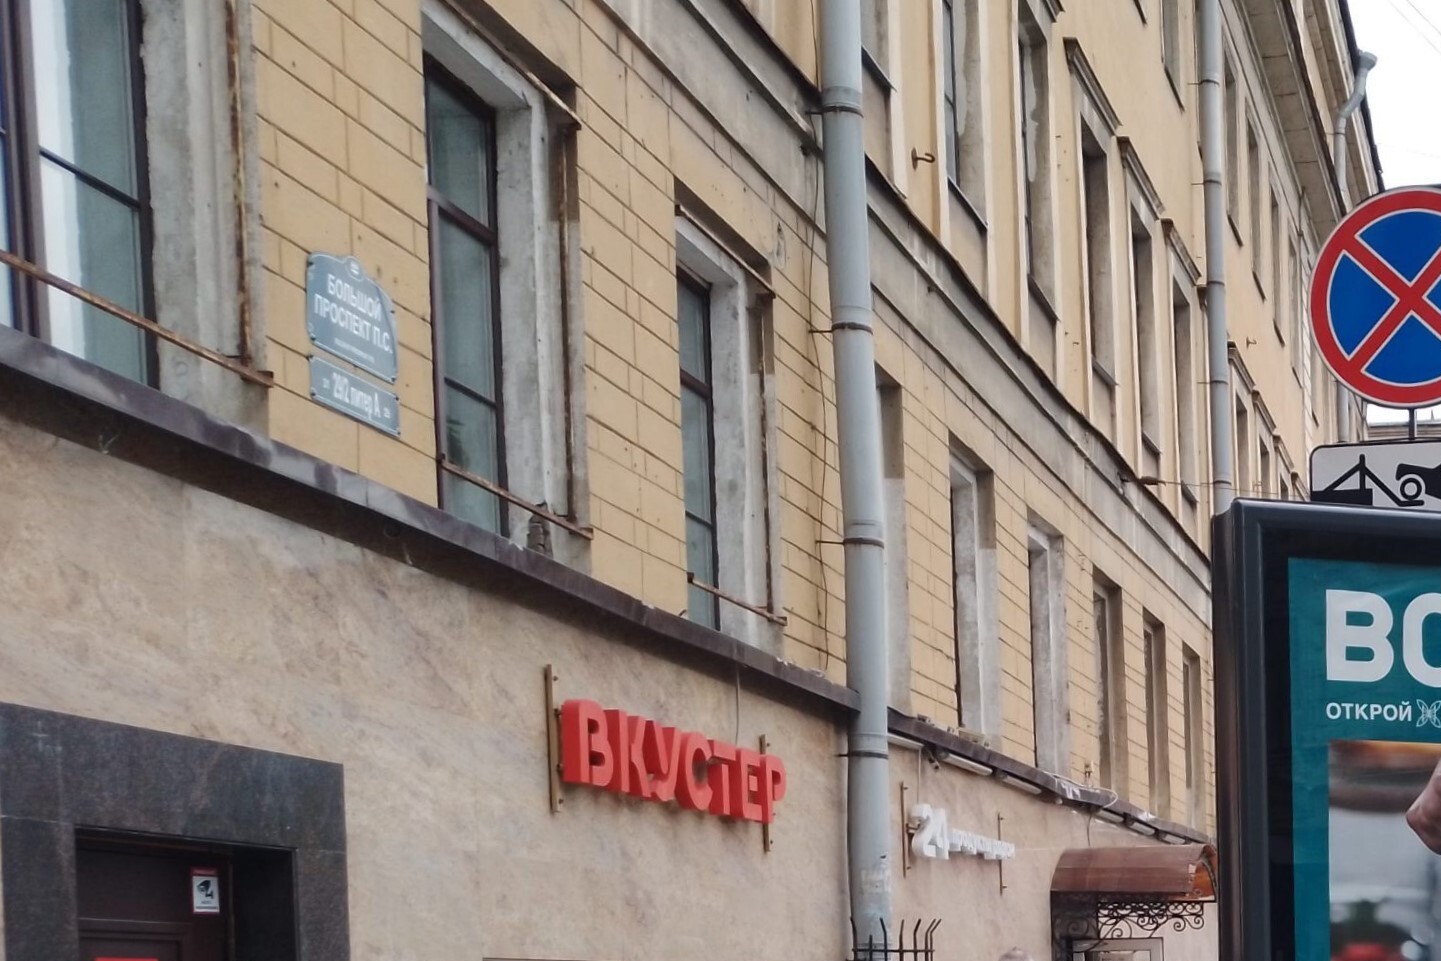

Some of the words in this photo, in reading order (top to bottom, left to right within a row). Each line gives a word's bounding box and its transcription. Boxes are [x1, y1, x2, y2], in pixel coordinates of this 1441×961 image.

[314, 293, 371, 341] ПРОСПЕКТ
[328, 273, 382, 322] БОЛЬШОЙ
[1326, 701, 1412, 721] ОТКРОЙ
[561, 699, 787, 824] ВКУСТЕР
